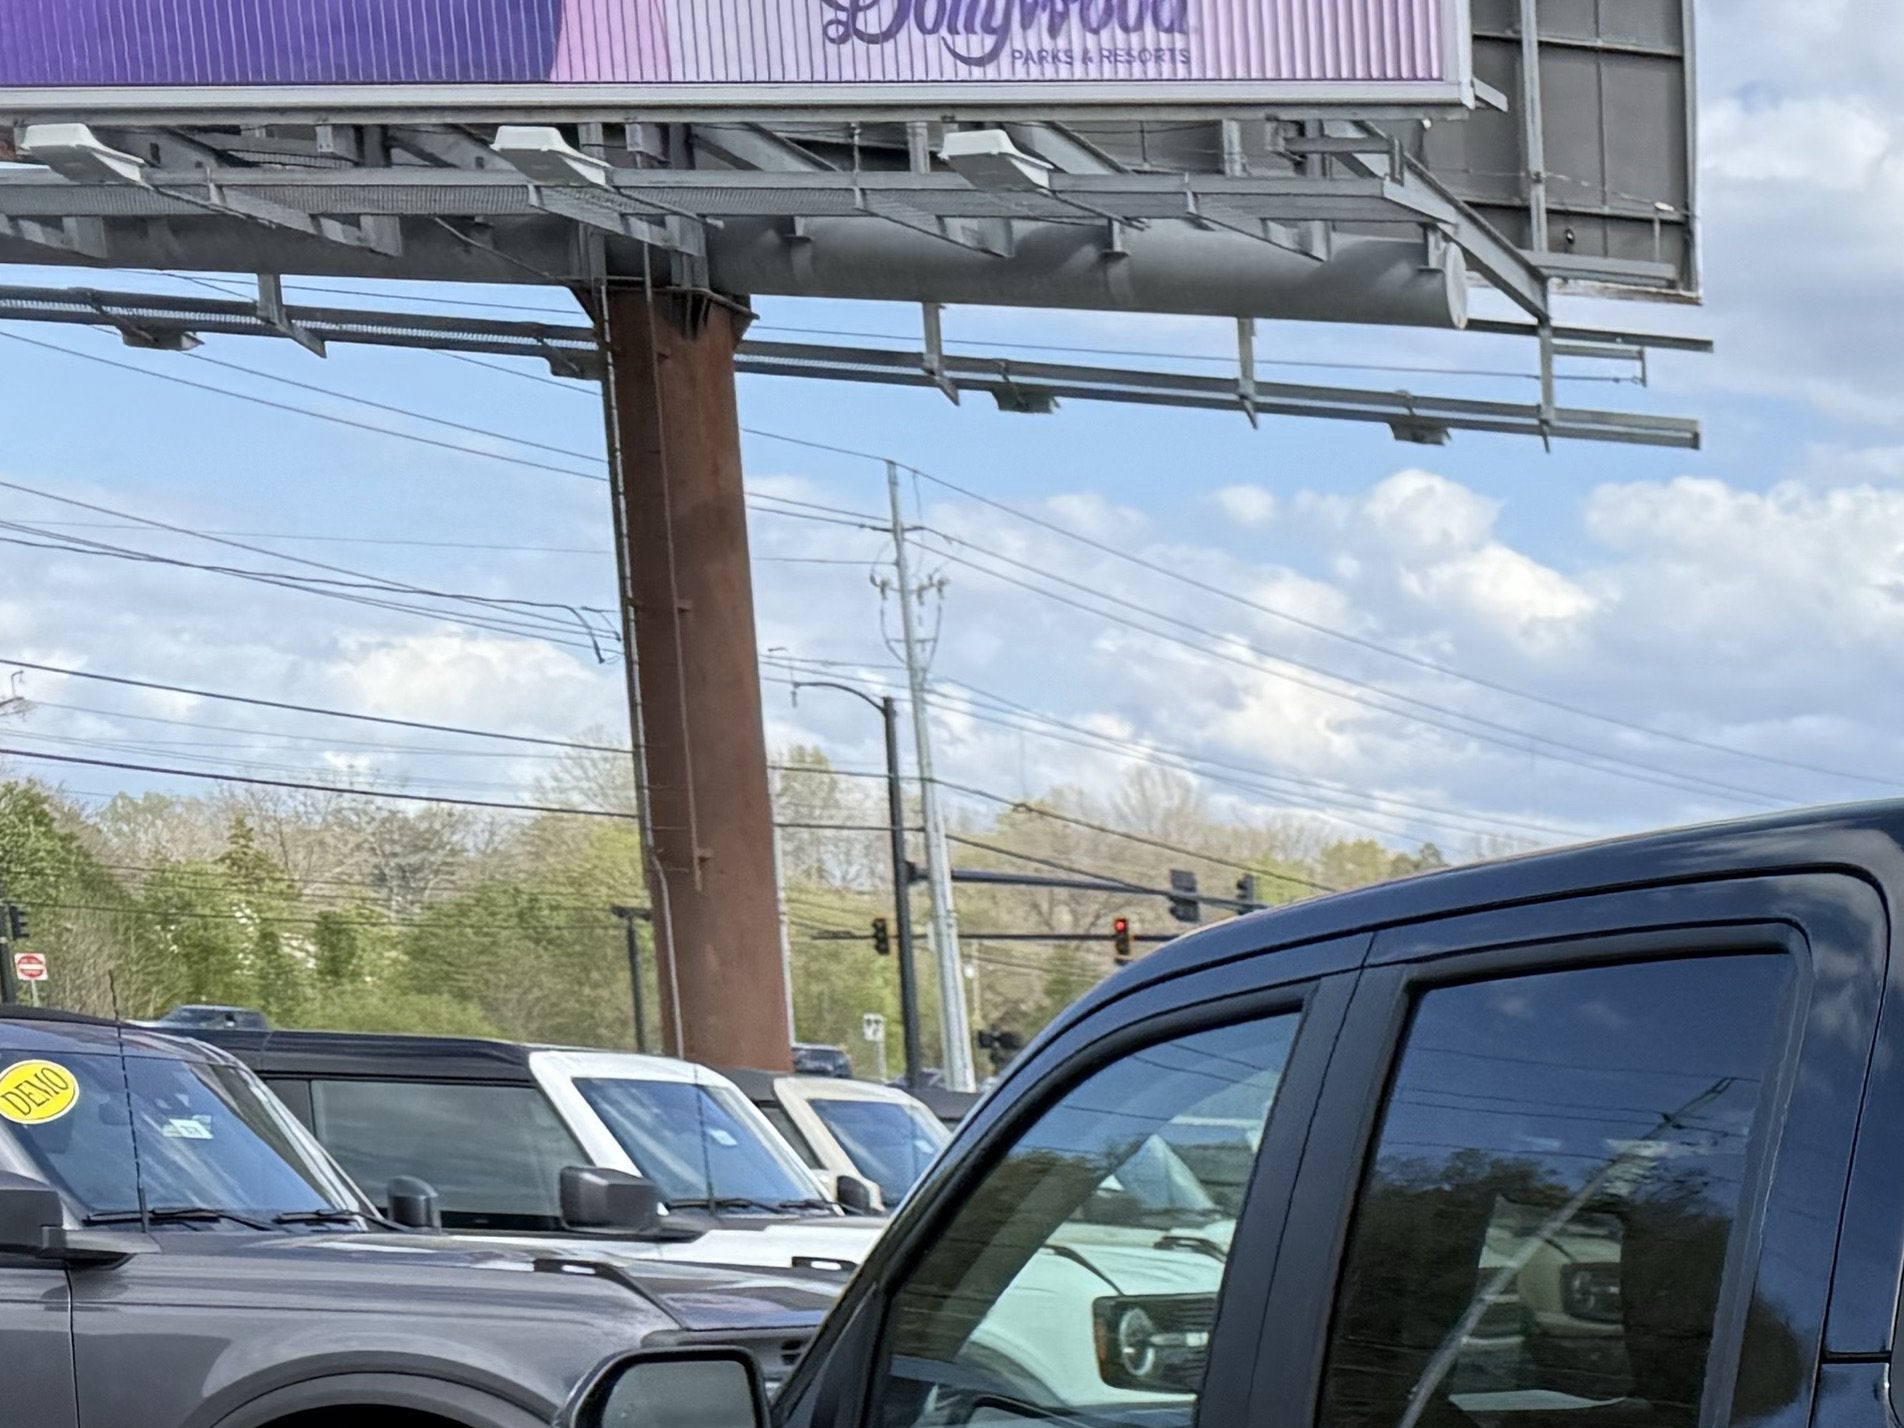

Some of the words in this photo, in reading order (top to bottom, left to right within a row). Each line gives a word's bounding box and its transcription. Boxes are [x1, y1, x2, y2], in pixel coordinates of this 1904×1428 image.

[1011, 48, 1073, 66] PARKS
[1081, 49, 1095, 65] &
[1101, 48, 1191, 66] RESORTS
[1, 1067, 69, 1116] DEMO
